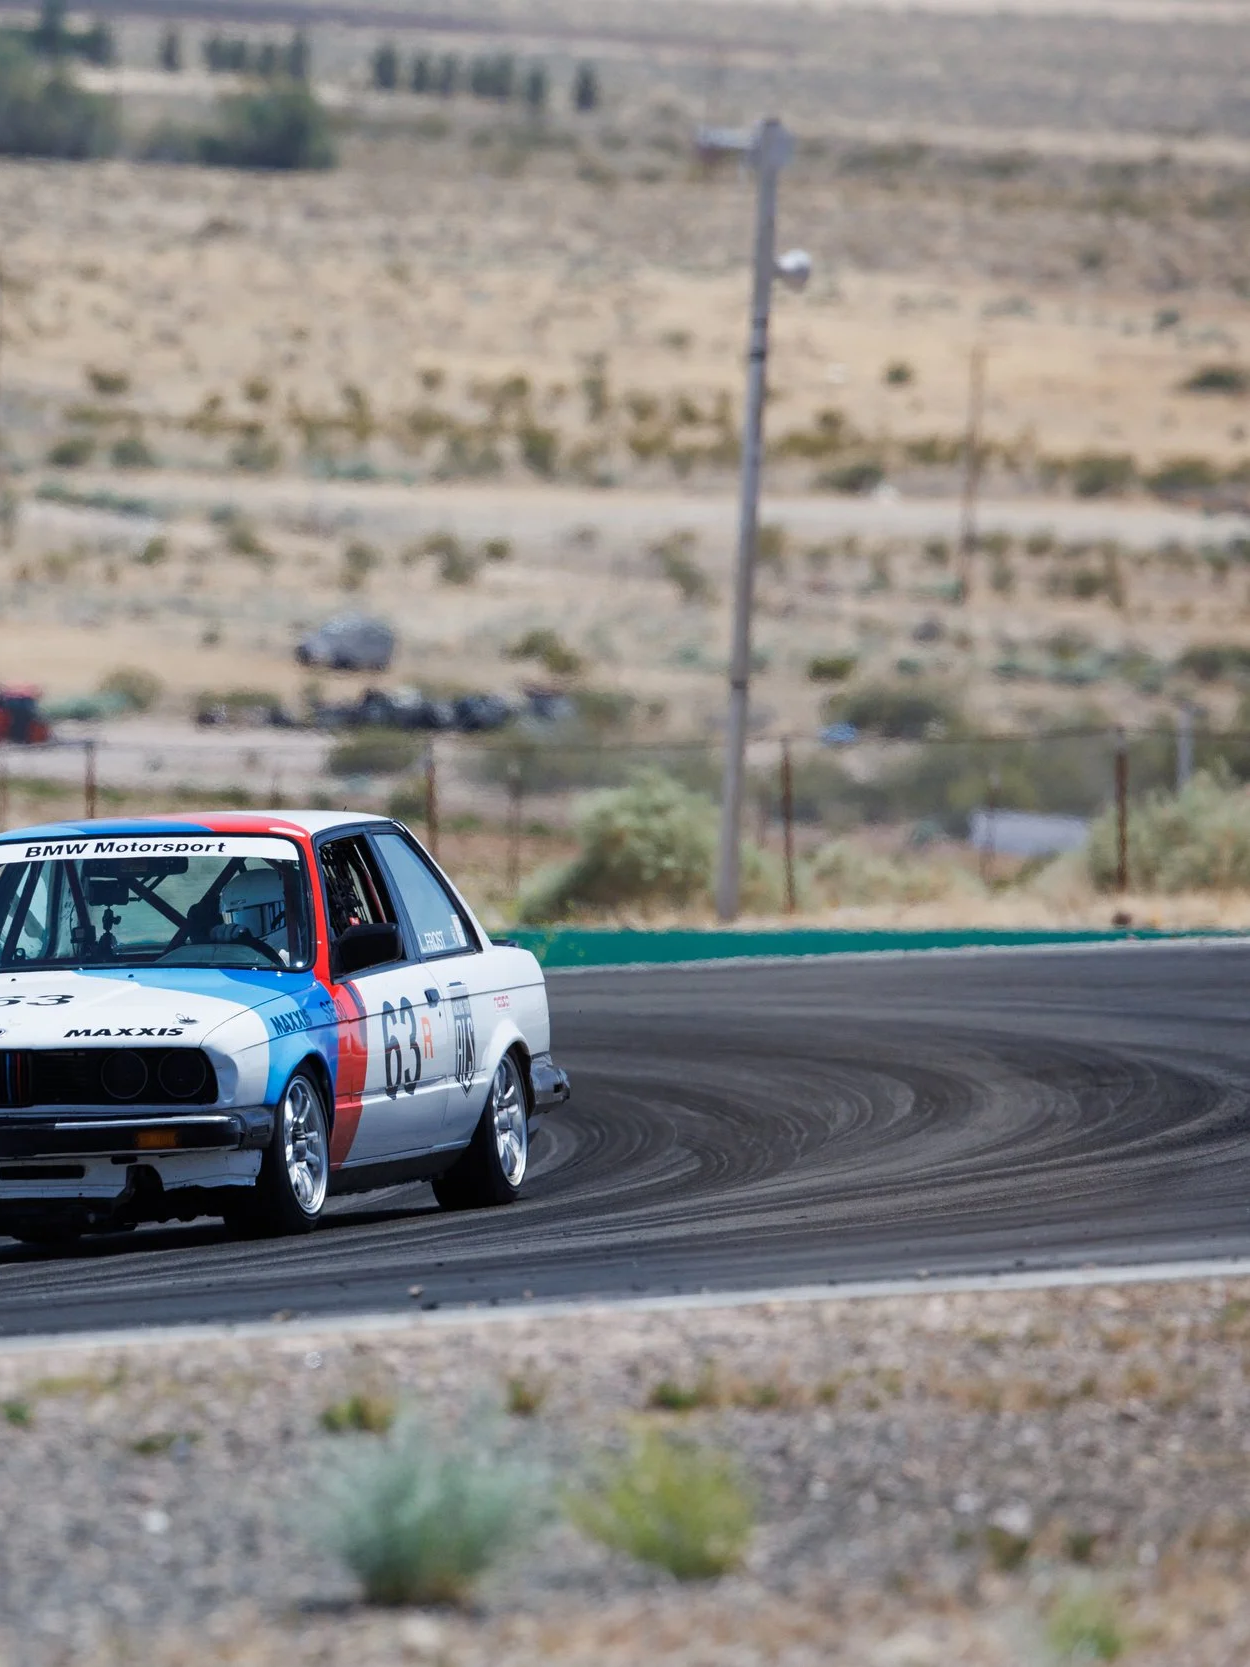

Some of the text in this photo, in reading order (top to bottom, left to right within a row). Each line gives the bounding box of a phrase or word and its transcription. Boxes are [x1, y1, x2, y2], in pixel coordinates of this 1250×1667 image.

[25, 842, 227, 858] BMW Motorsport
[64, 1027, 185, 1038] MAXXIS
[270, 1008, 313, 1035] MAXXIS
[382, 996, 421, 1100] 63
[421, 1016, 434, 1059] R
